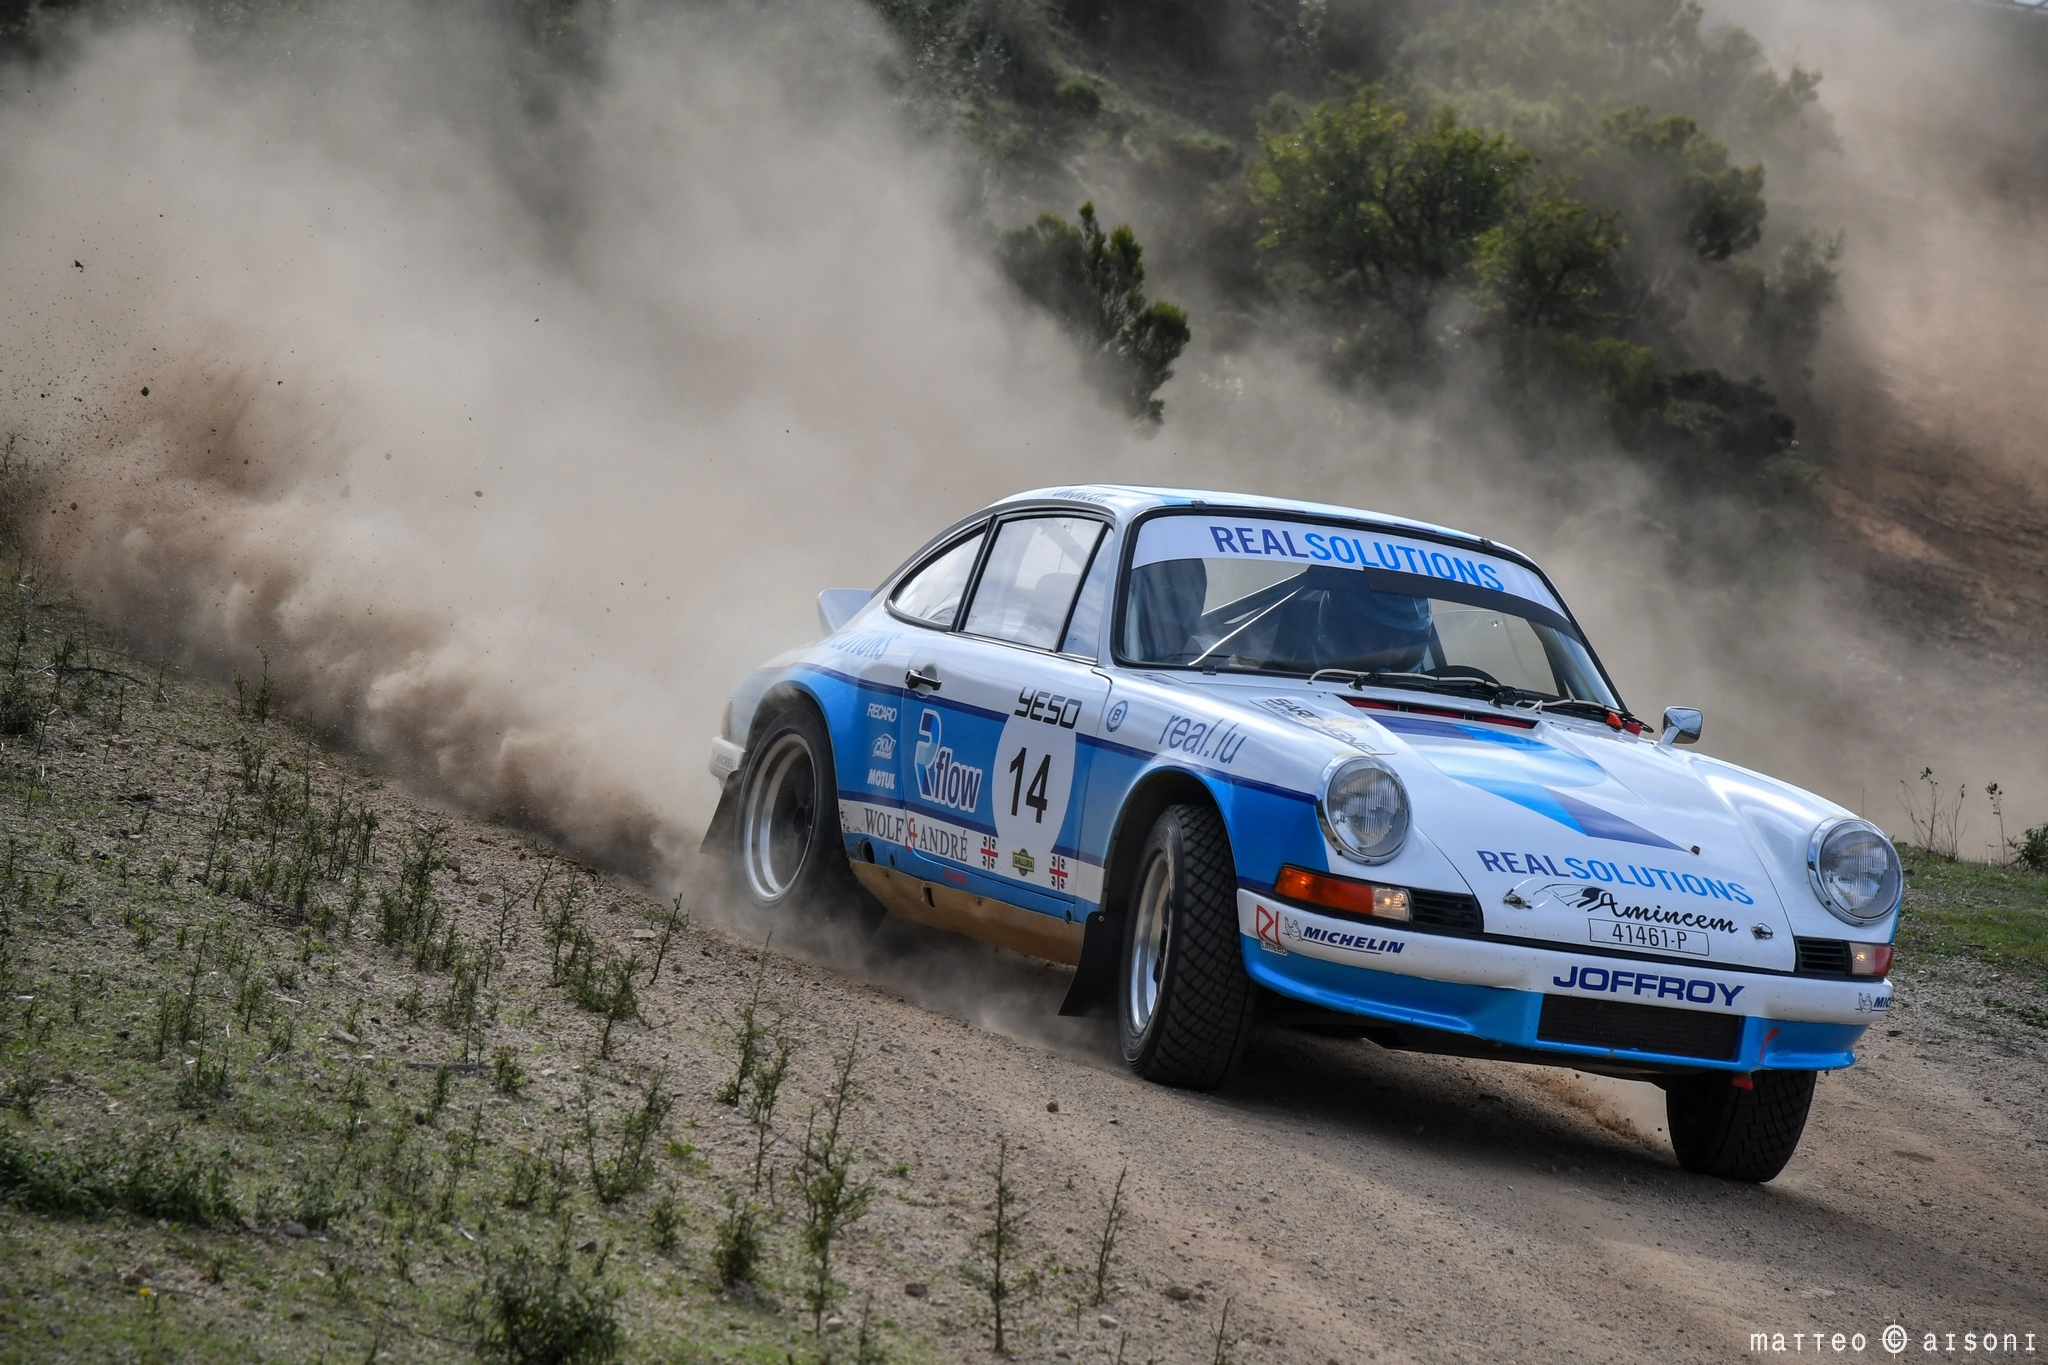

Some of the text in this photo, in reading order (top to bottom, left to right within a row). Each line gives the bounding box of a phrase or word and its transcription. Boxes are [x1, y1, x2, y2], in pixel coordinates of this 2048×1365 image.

[1209, 526, 1505, 592] REALSOLUTIONS
[866, 702, 898, 723] RECARO
[1014, 686, 1083, 730] YESO
[1158, 714, 1248, 764] real.lu
[867, 768, 896, 790] MOTUL
[1009, 746, 1052, 824] 14
[864, 807, 904, 843] WOLF
[919, 824, 968, 863] ANDRÉ
[1476, 850, 1755, 906] REALSOLUTIONS
[1587, 891, 1739, 934] Amincem
[1303, 926, 1405, 954] MICHELIN
[1612, 923, 1688, 950] 41461-P
[1552, 965, 1746, 1007] JOFFROY
